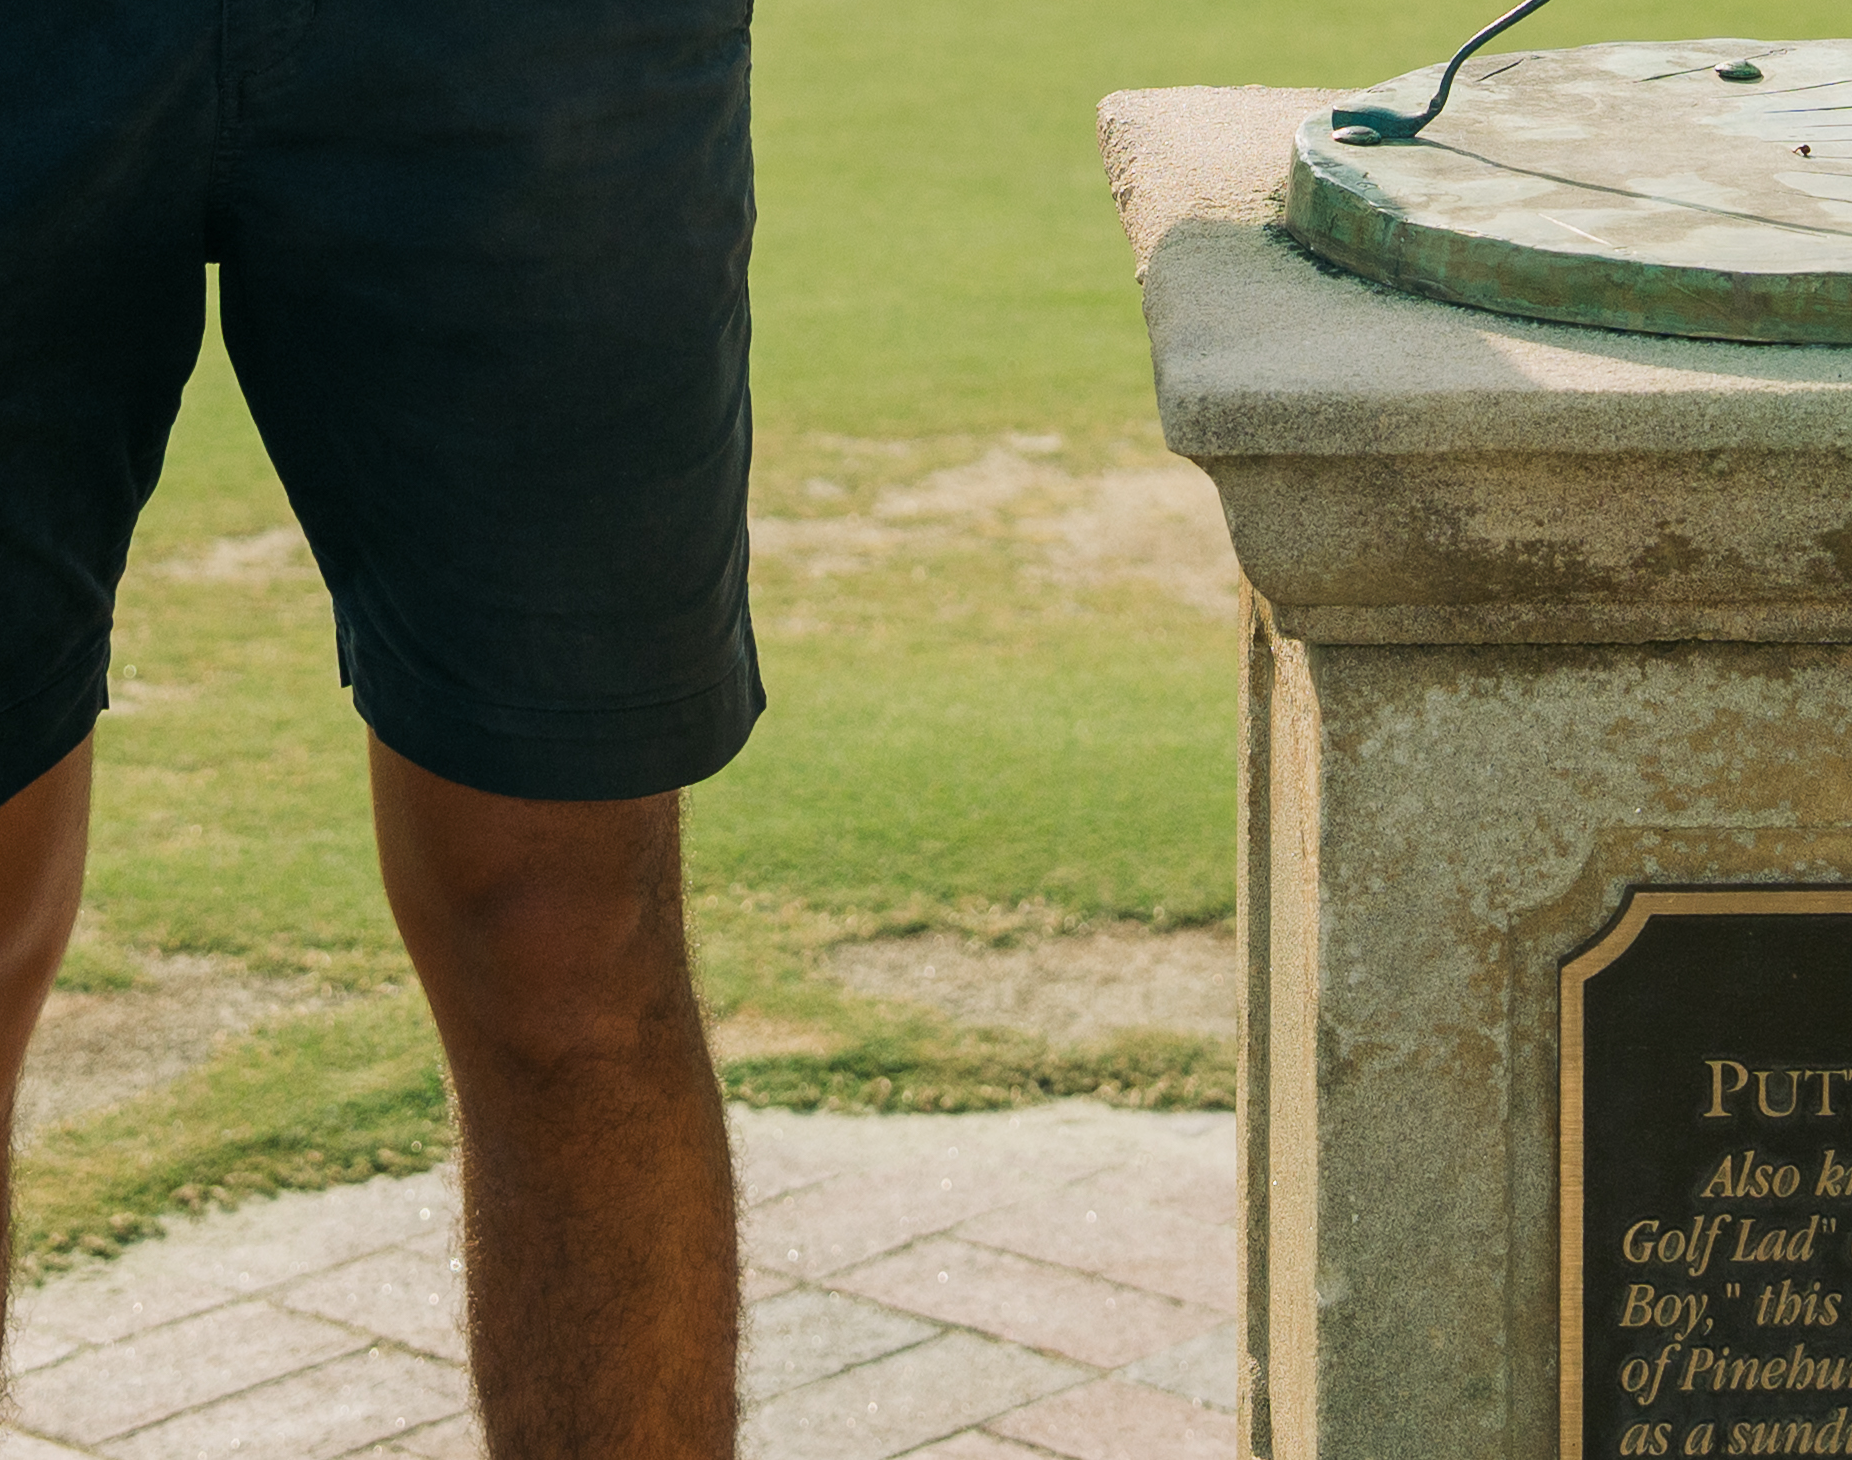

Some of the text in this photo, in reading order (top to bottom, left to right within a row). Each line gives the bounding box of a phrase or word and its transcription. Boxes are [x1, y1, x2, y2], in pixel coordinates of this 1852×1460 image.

[1700, 1151, 1800, 1197] Also
[1623, 1214, 1732, 1276] Golf
[1757, 1279, 1841, 1325] this
[1619, 1343, 1680, 1406] of
[1620, 1423, 1669, 1455] as
[1685, 1424, 1713, 1455] a
